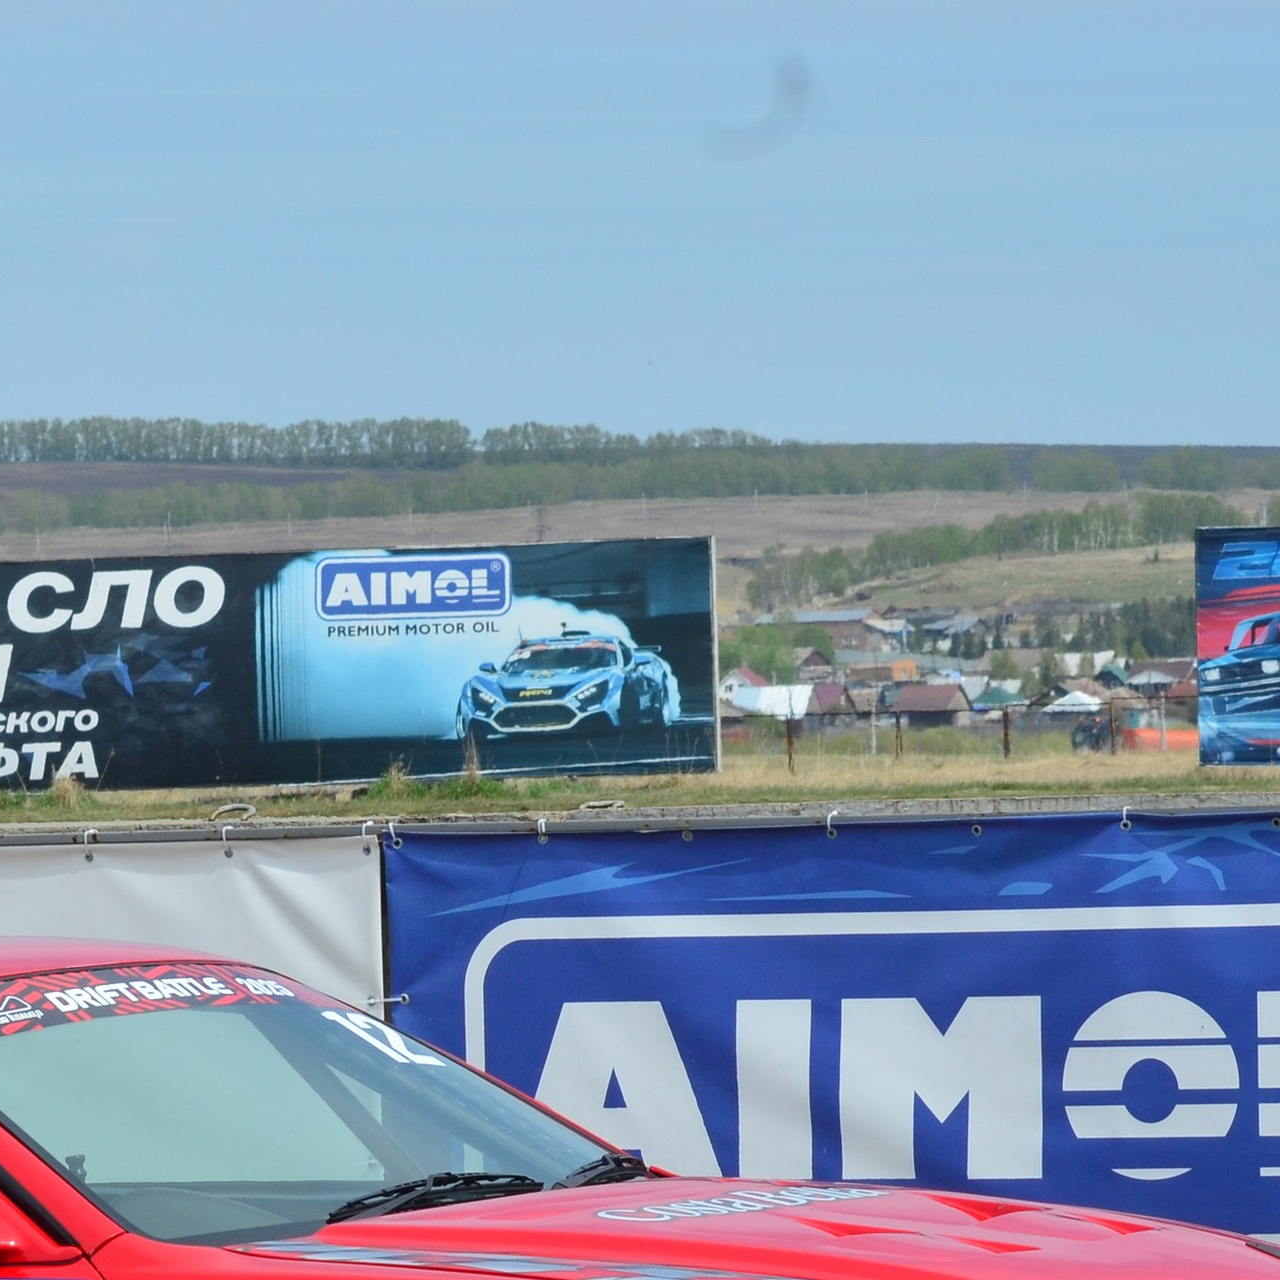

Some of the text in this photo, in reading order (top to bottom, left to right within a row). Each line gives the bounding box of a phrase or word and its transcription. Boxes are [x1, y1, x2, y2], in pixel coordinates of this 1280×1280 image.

[326, 569, 500, 607] AIMOL
[327, 621, 500, 637] PREMIUM MOTOR OIL
[44, 981, 132, 1013] DRIFT
[321, 1007, 447, 1067] 12
[533, 988, 1280, 1182] AIMO
